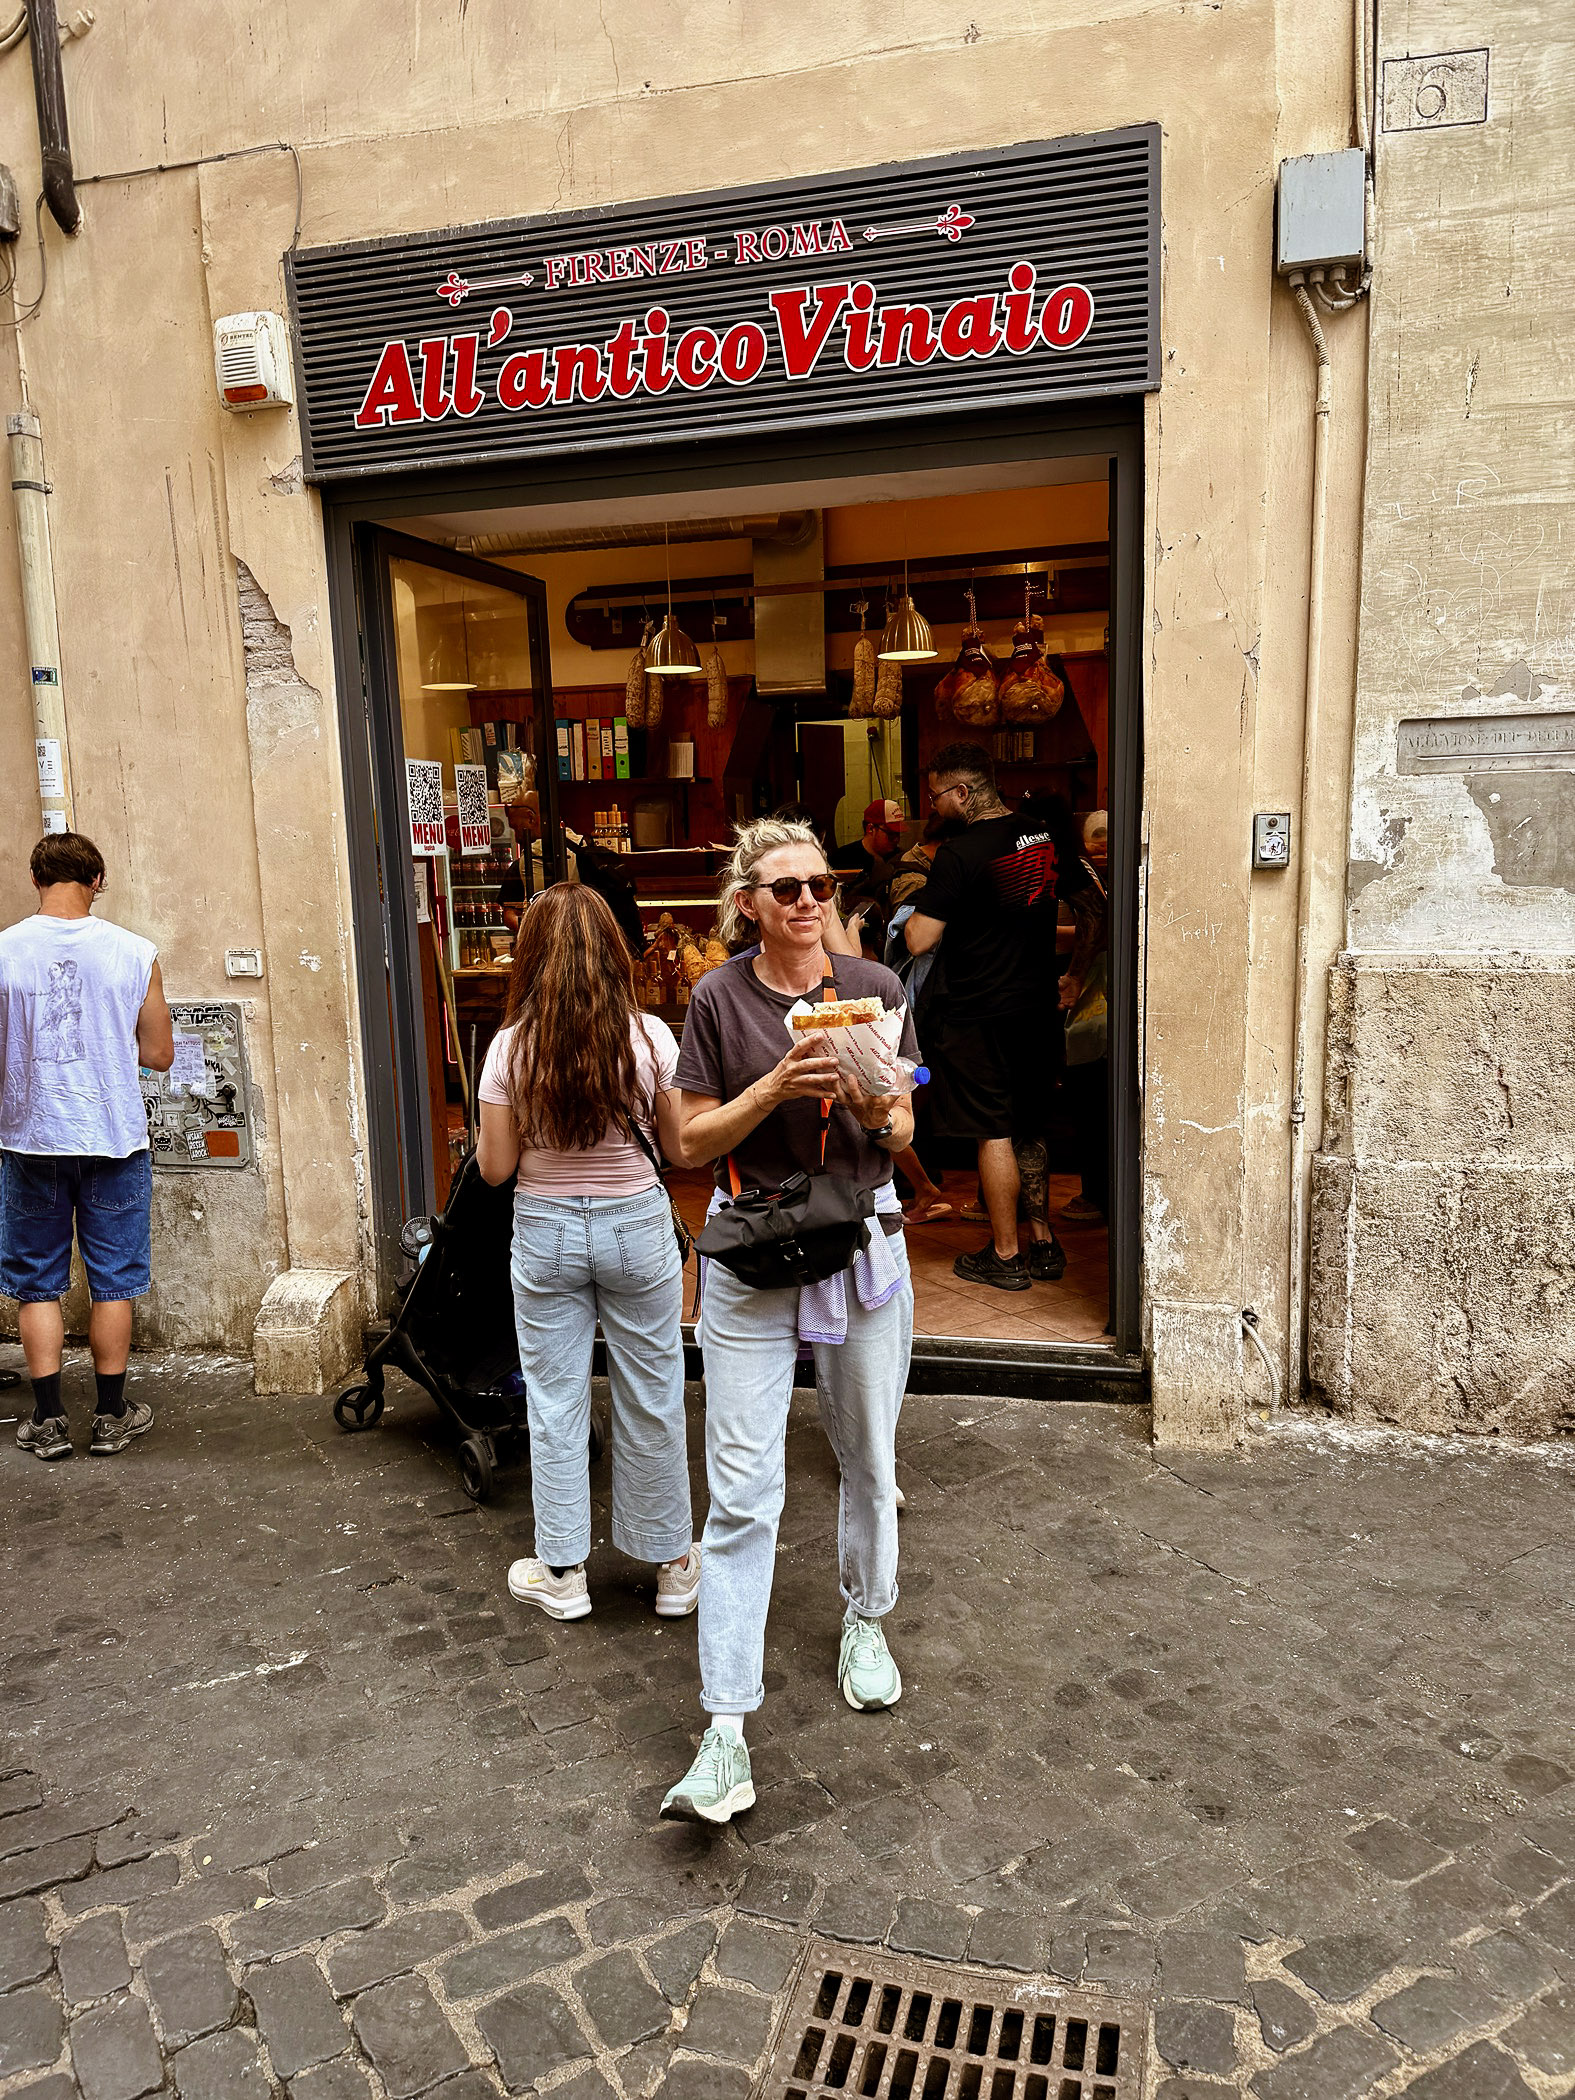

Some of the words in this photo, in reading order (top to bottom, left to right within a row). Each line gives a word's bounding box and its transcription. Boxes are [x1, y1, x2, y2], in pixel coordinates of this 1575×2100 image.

[1416, 65, 1456, 119] 6
[544, 236, 708, 290] FIRENZE
[735, 218, 853, 265] ROMA
[355, 306, 768, 430] All'antico
[768, 261, 1094, 380] Vinaio
[411, 823, 444, 845] MENU
[461, 824, 491, 848] MENU
[1015, 832, 1050, 849] ellesse
